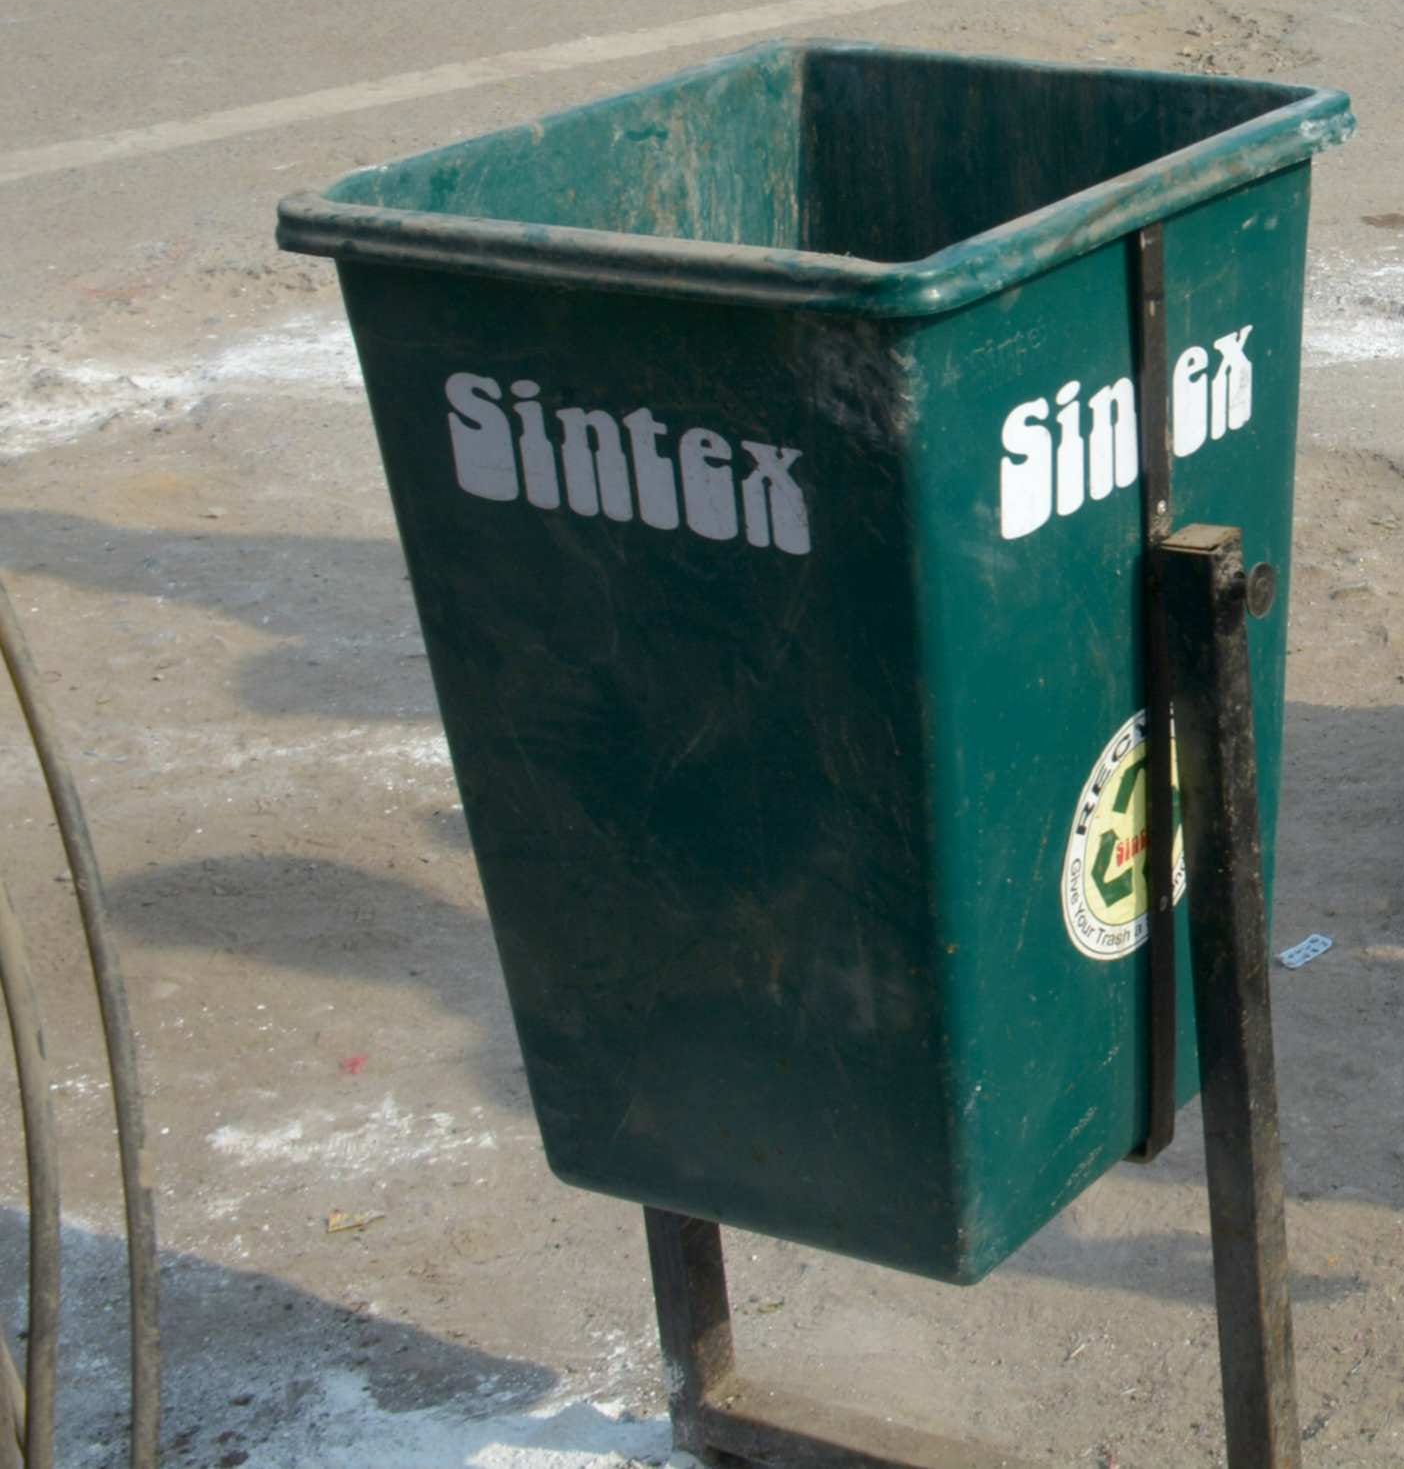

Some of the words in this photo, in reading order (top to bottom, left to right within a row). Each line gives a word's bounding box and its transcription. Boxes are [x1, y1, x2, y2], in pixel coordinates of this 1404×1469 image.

[1001, 324, 1253, 540] Sinex
[444, 371, 812, 556] Sintex
[1068, 857, 1083, 907] Give
[1073, 903, 1097, 939] Your
[1096, 928, 1131, 949] Trash
